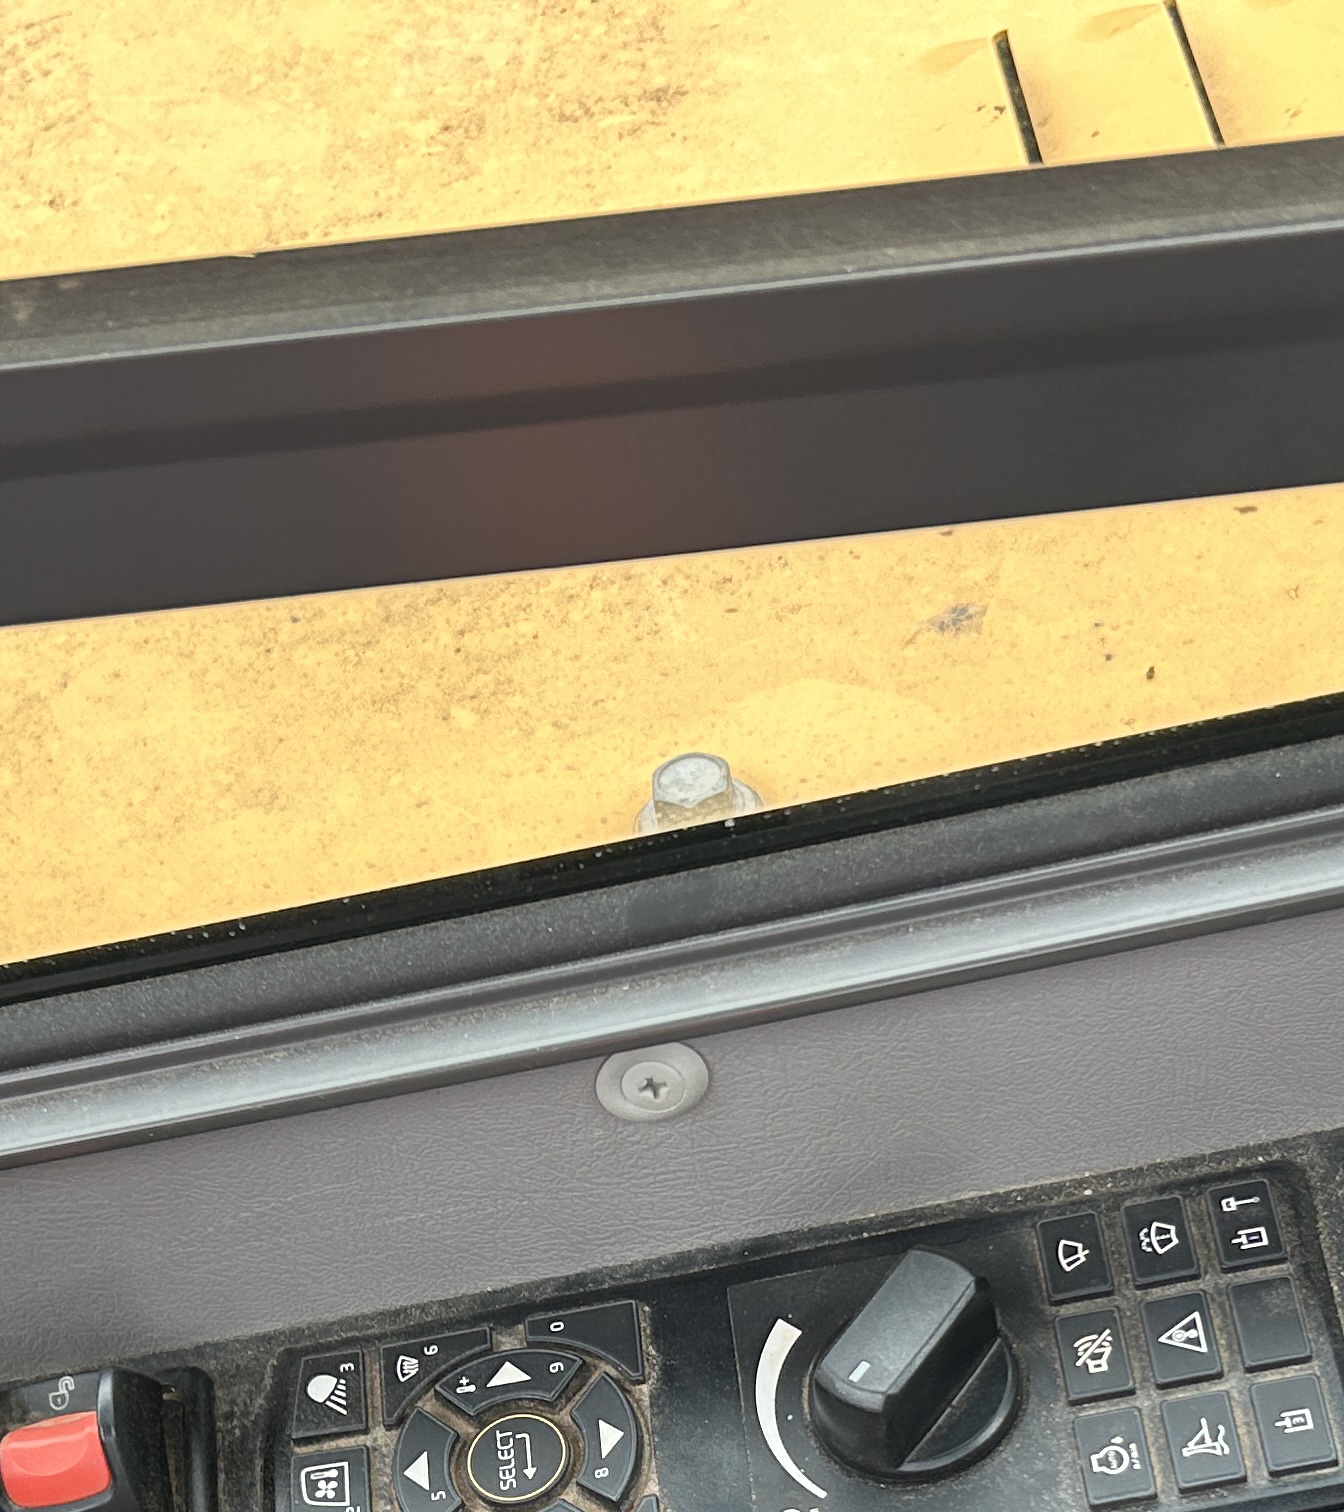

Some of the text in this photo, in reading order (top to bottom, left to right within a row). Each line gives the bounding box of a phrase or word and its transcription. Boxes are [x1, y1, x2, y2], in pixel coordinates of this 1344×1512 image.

[549, 1321, 565, 1332] 0
[423, 1344, 439, 1356] 6
[340, 1362, 355, 1373] 3
[549, 1361, 565, 1374] 9
[495, 1430, 518, 1491] SELECT
[594, 1467, 610, 1480] 8
[431, 1490, 447, 1501] 5
